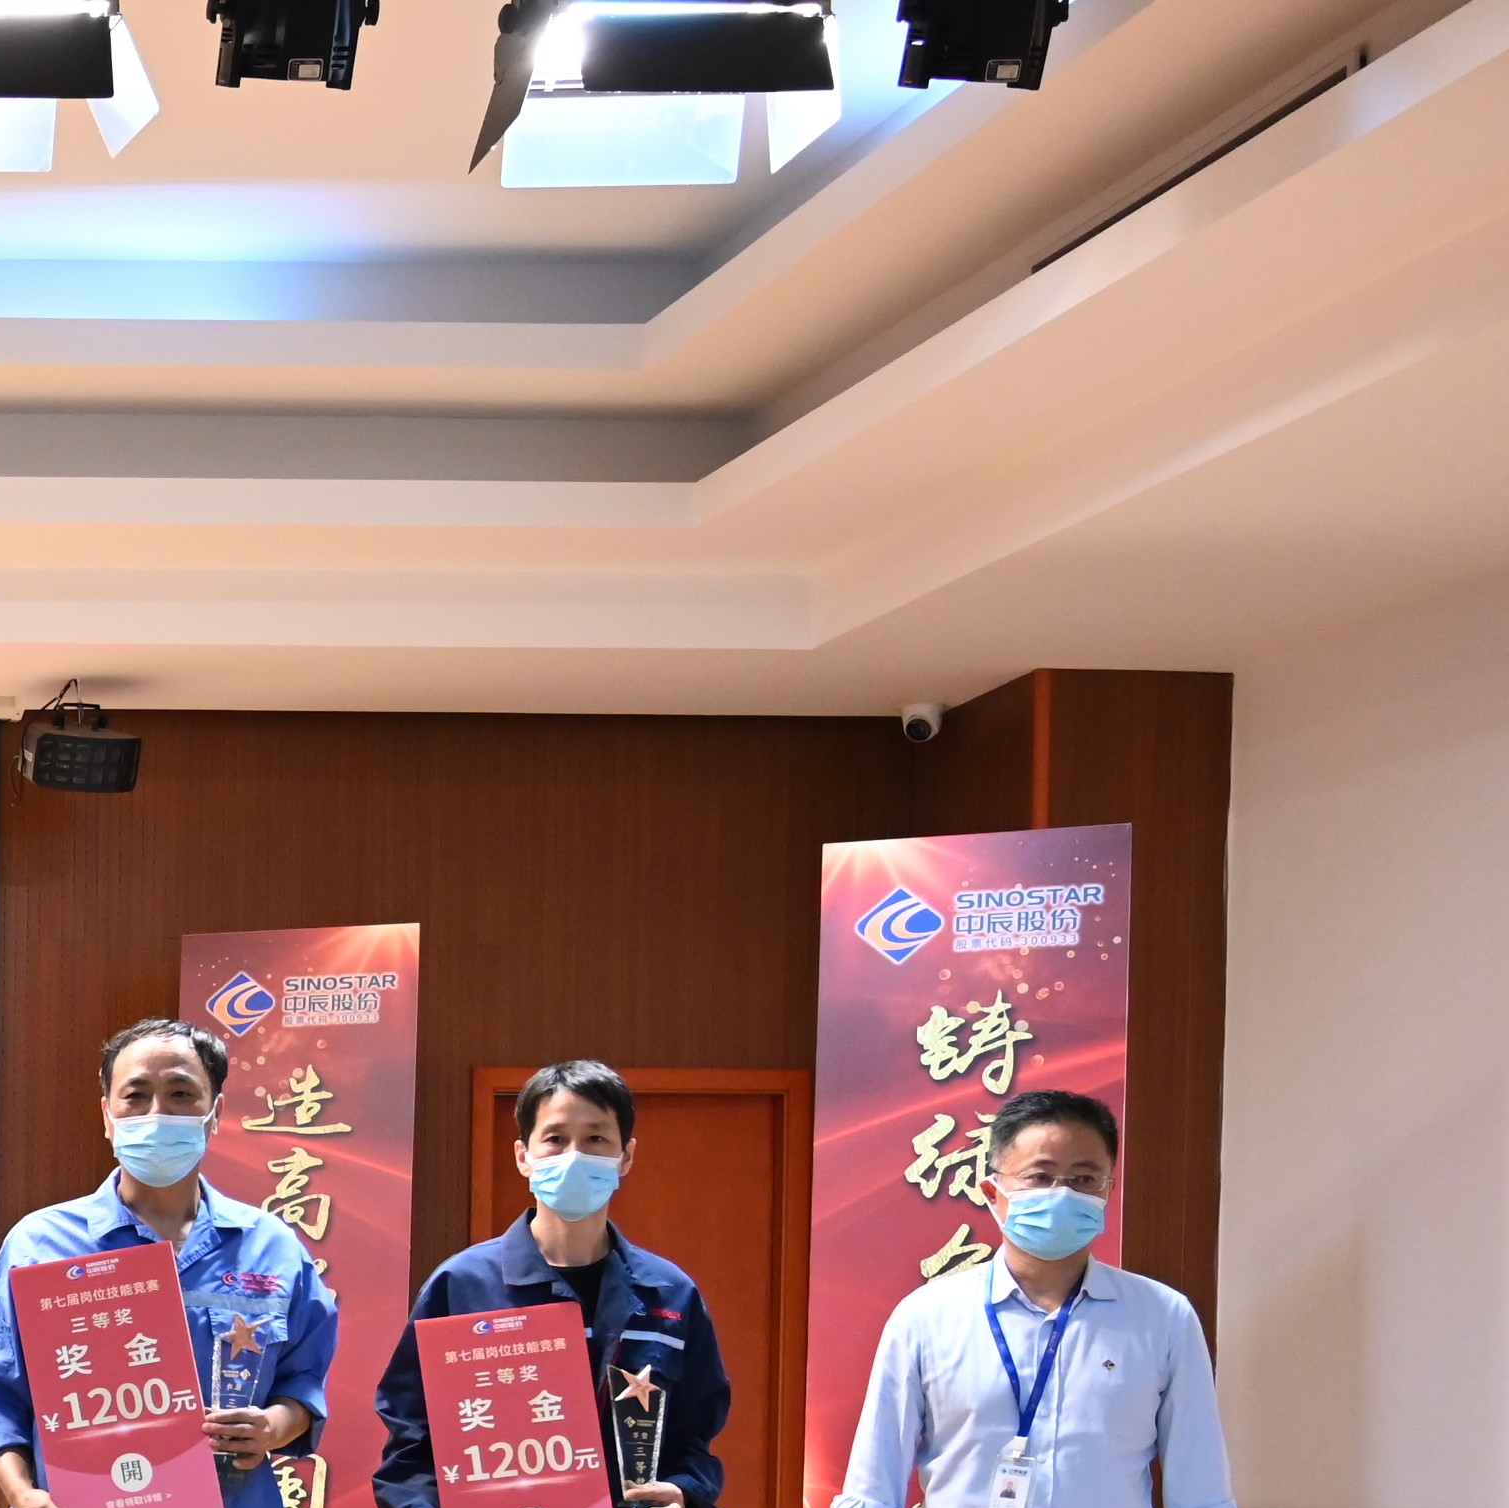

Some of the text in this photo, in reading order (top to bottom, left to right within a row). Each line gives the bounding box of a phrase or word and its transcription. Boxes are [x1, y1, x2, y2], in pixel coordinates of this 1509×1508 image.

[955, 886, 1103, 907] SINOSTAR
[955, 907, 1080, 936] 中辰股份
[285, 974, 397, 992] SINOSTAR
[284, 992, 379, 1013] 中辰股份
[39, 1279, 160, 1311] 第七届岗位技能竞赛
[70, 1307, 133, 1333] 三等奖
[56, 1332, 161, 1379] 奖金
[444, 1337, 567, 1365] 第七届岗位技能竞赛
[474, 1364, 539, 1388] 三等奖
[458, 1389, 565, 1432] 奖金
[121, 1460, 143, 1483] 開
